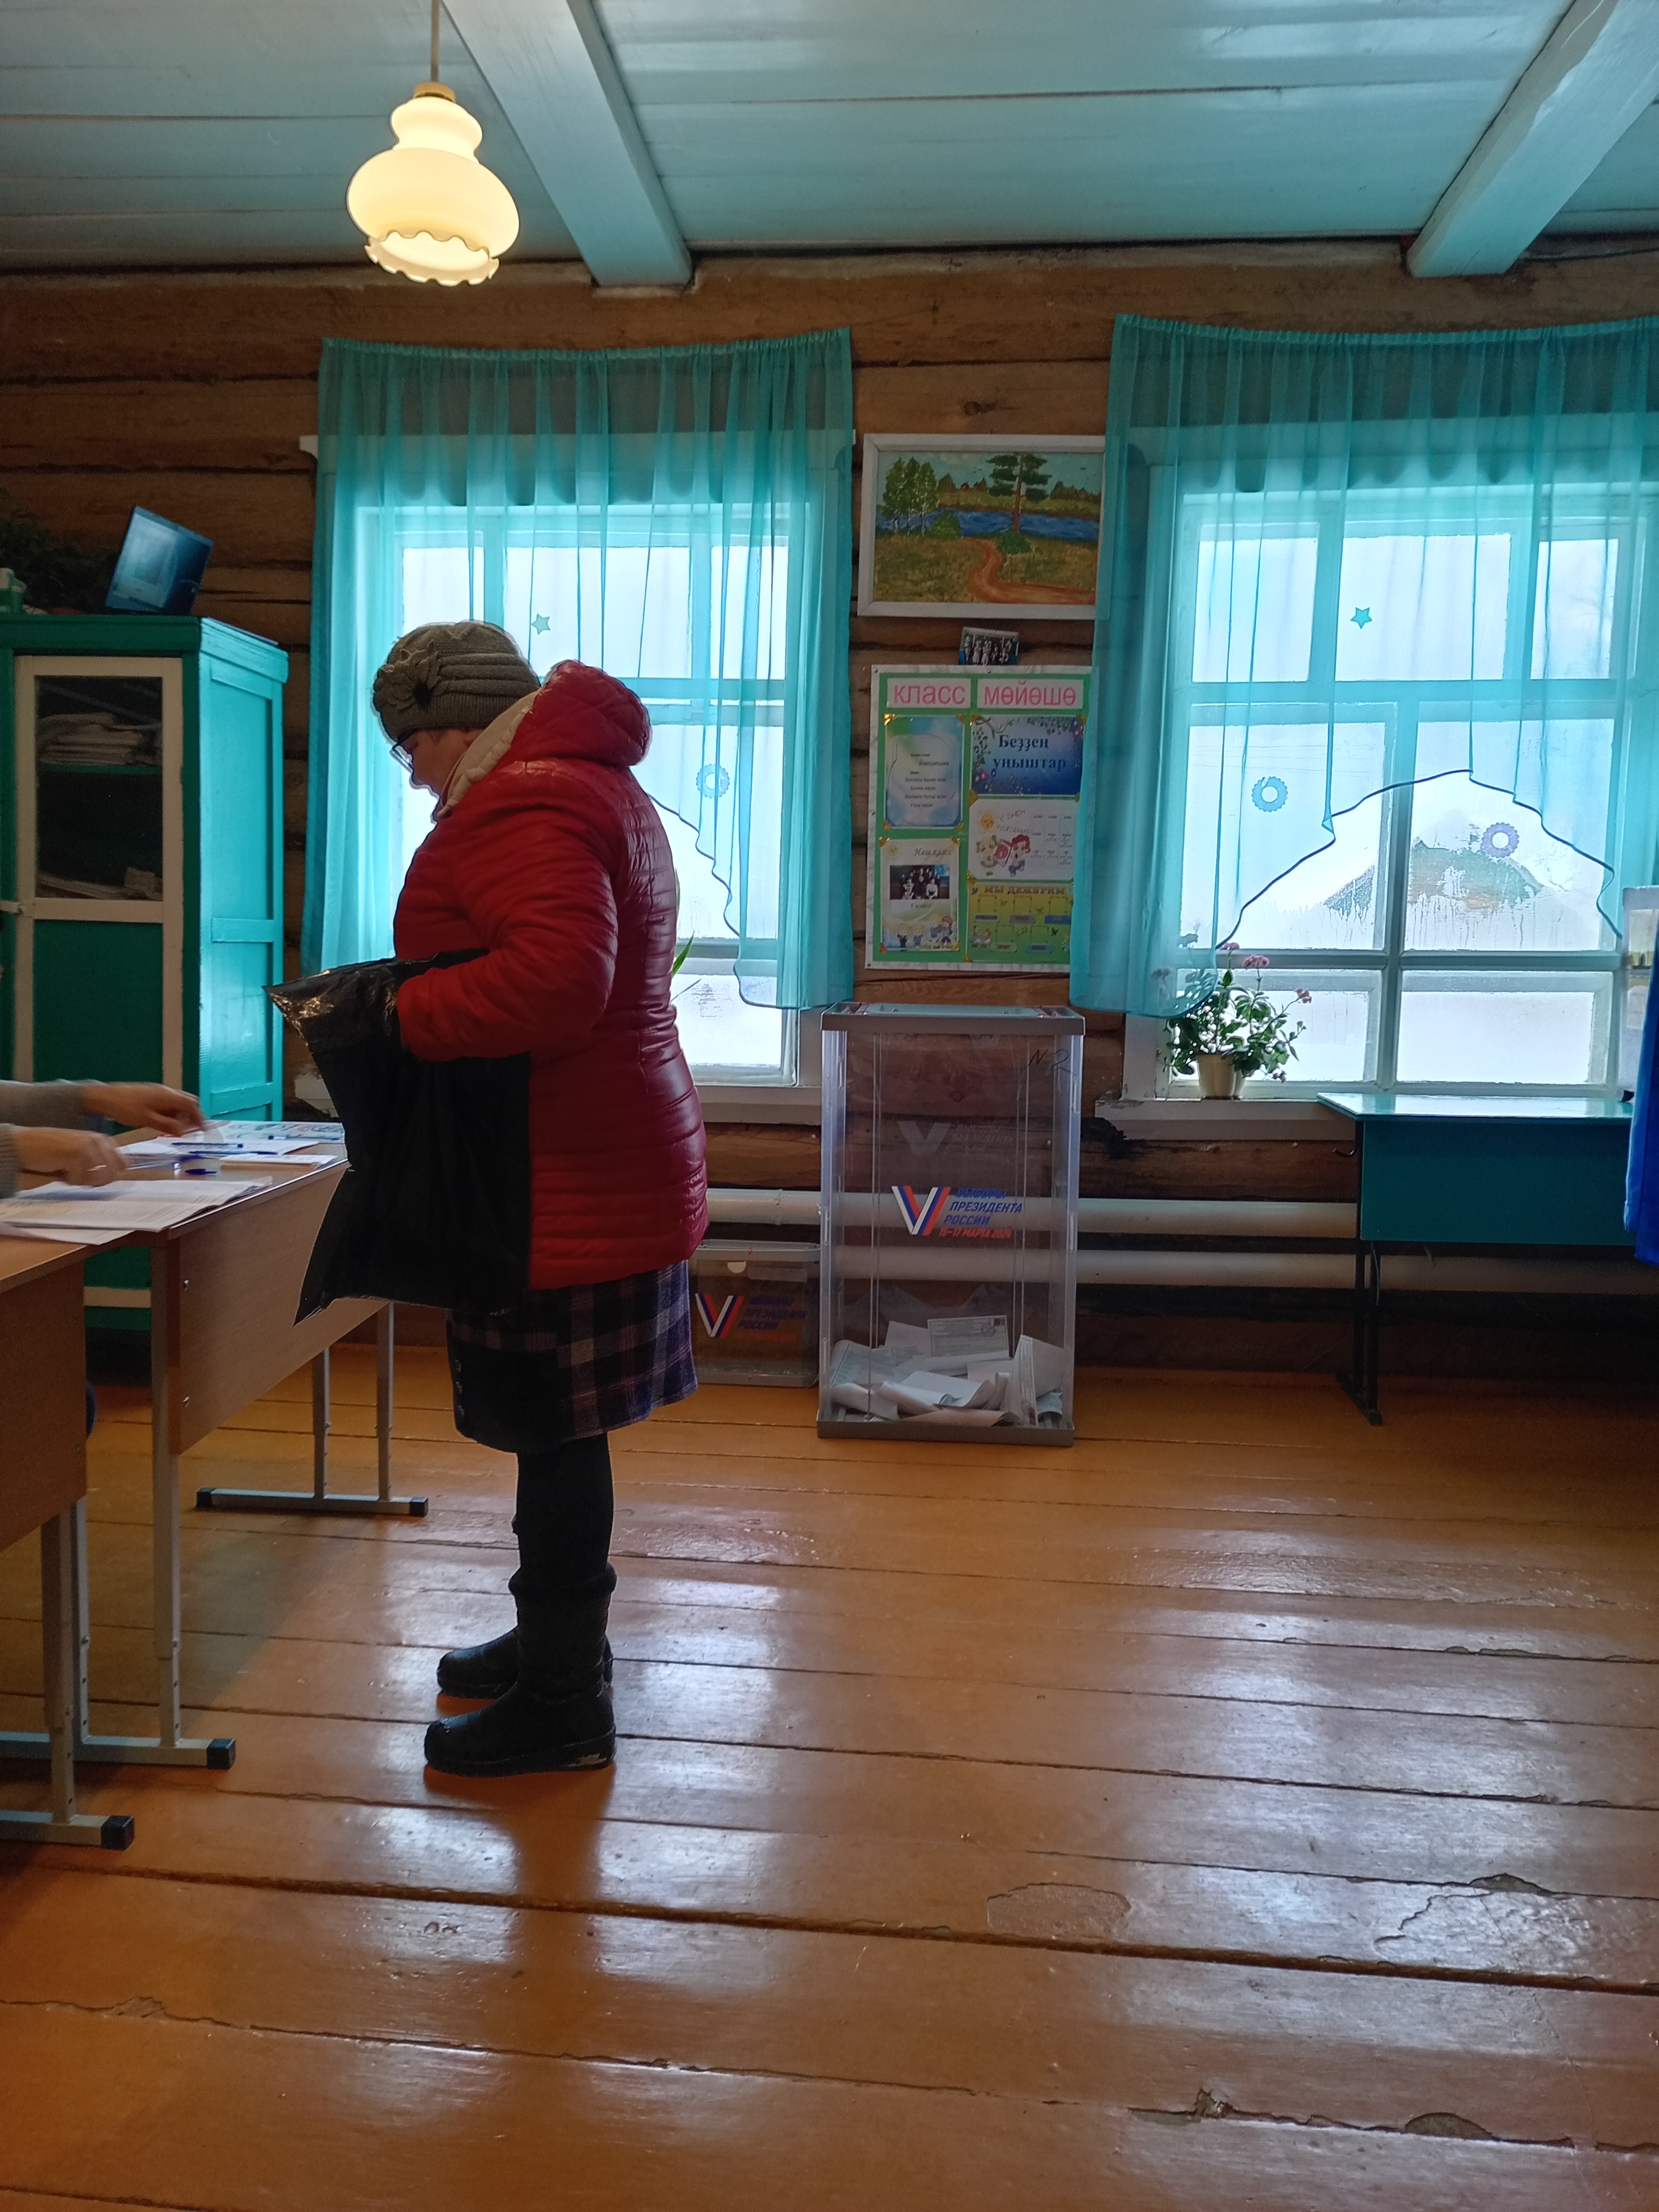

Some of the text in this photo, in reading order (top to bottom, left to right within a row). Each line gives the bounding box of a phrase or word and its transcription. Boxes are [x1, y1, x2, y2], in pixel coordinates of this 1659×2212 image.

[956, 1188, 1008, 1199] ВЫБОРЫ
[949, 1201, 1022, 1213] ПРЕЗИДЕНТА
[943, 1215, 991, 1226] РОССИИ
[961, 1228, 990, 1238] МАРТА
